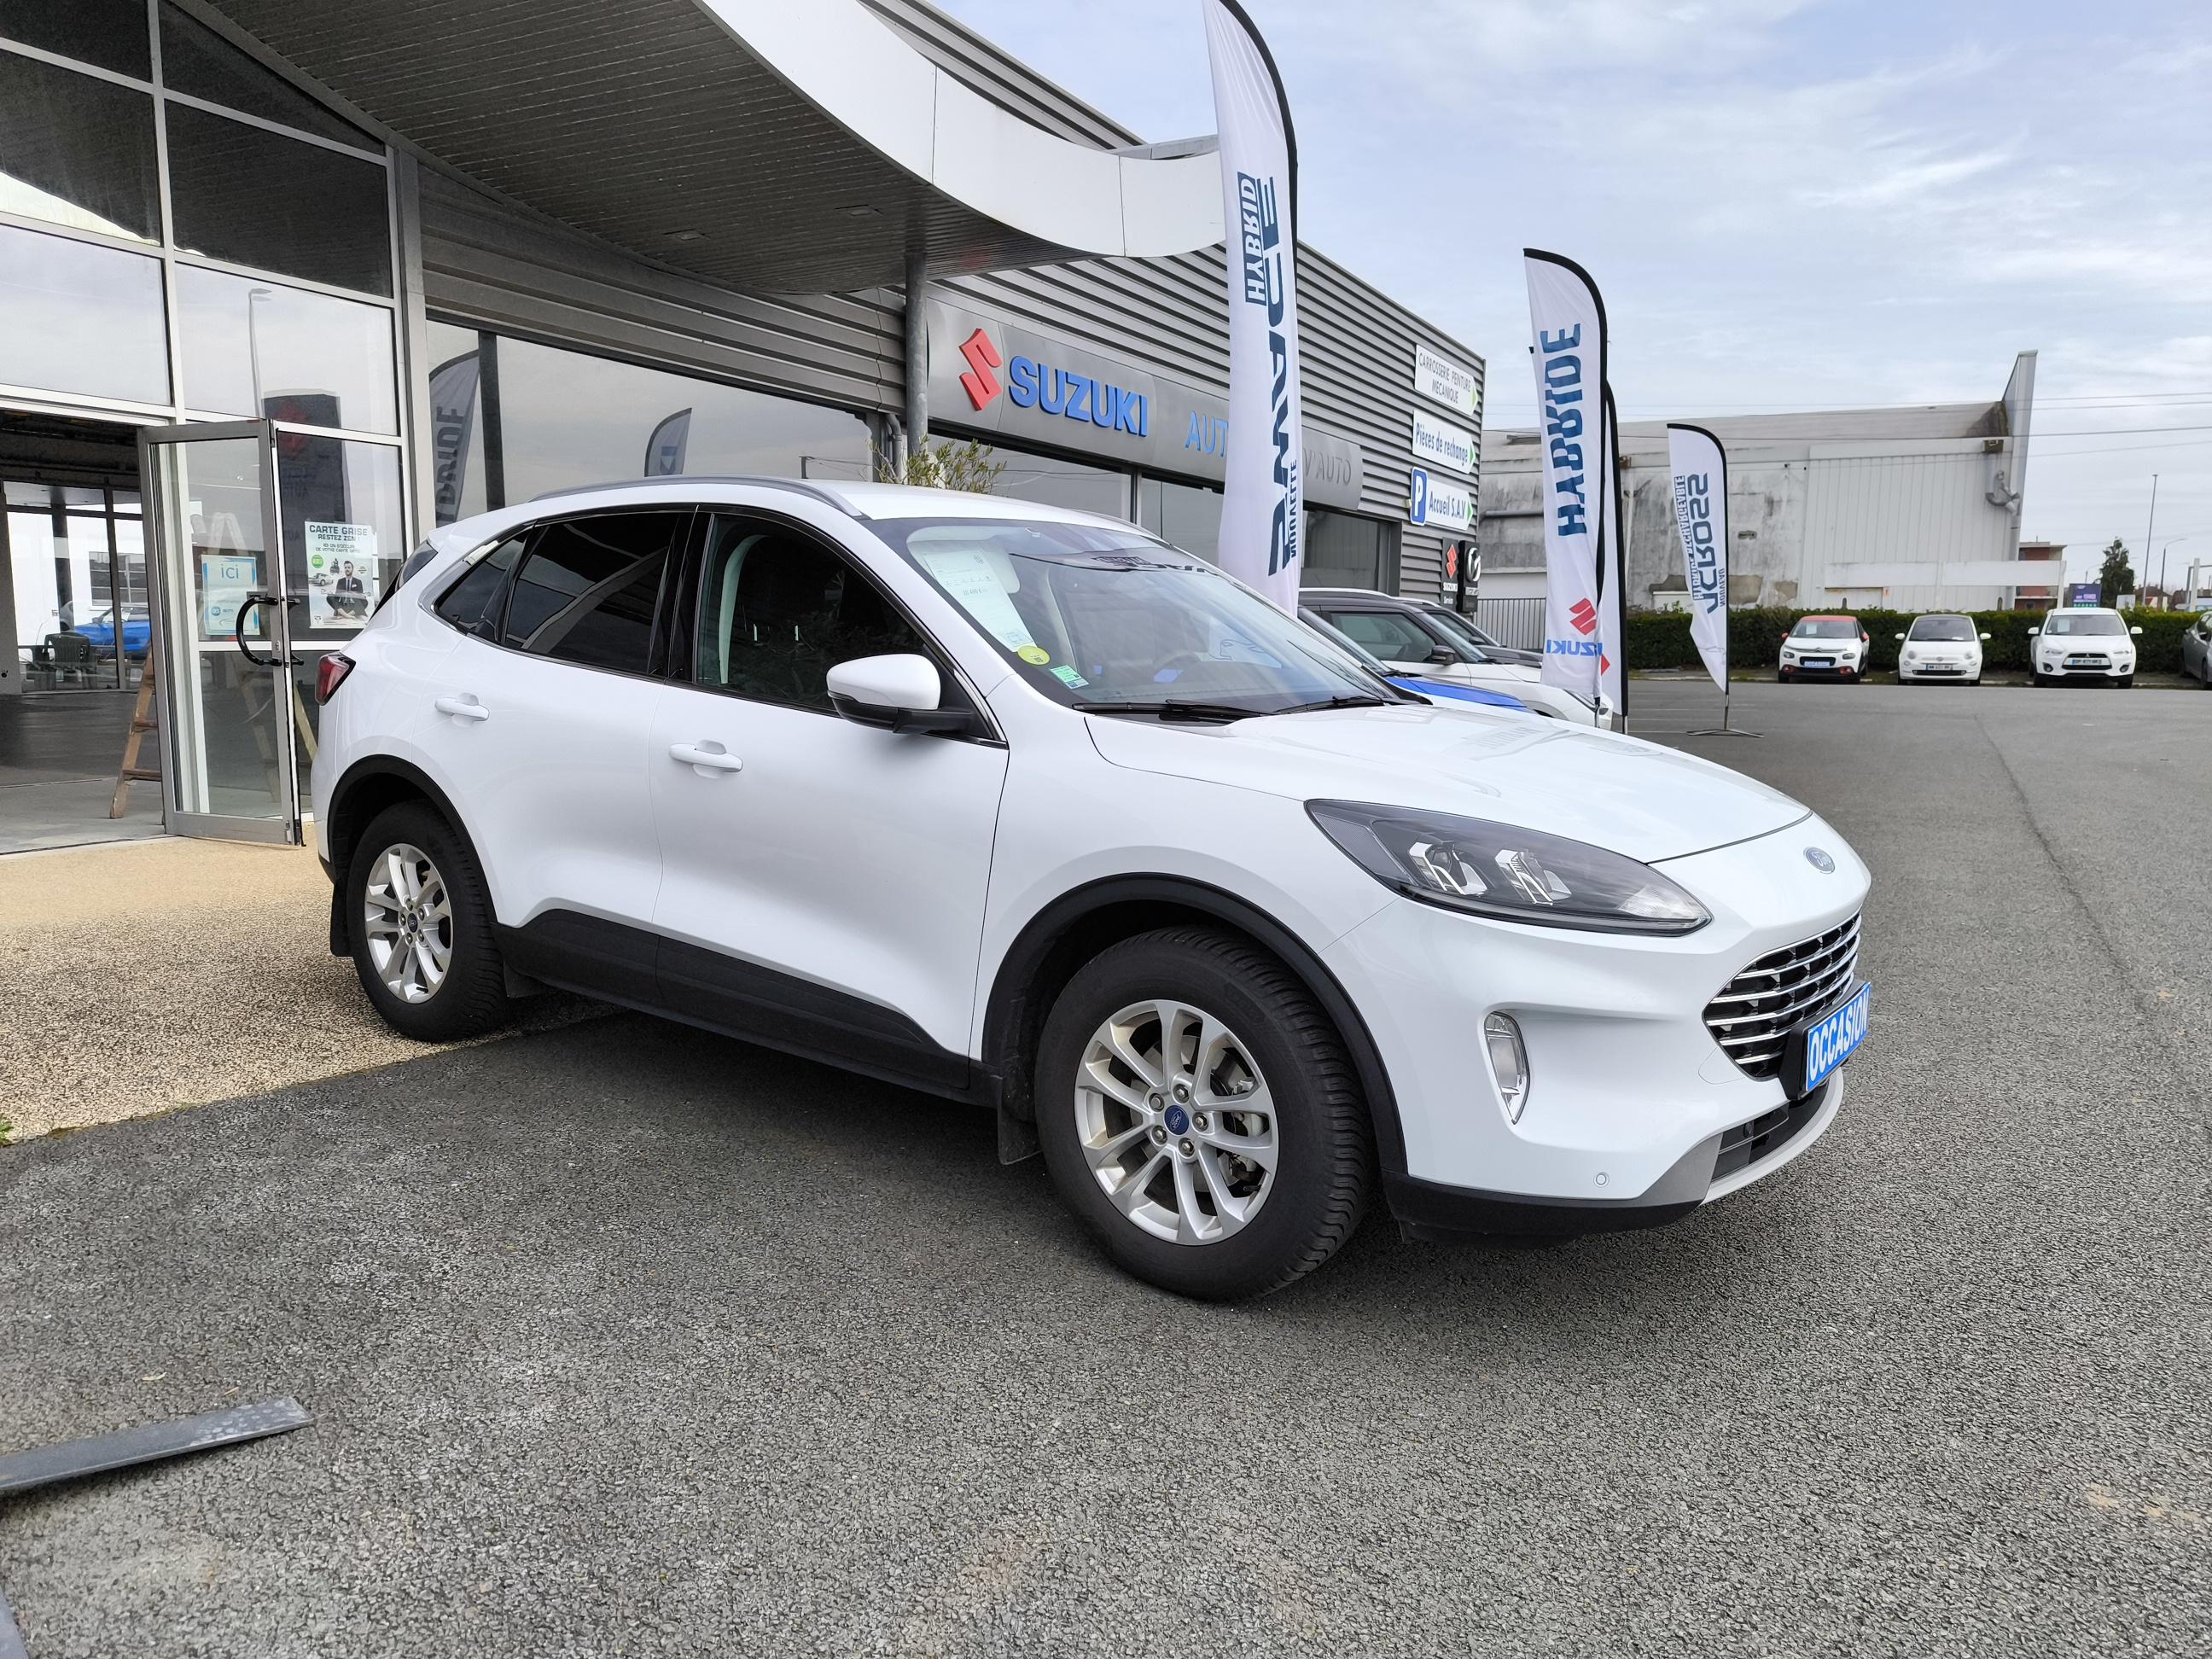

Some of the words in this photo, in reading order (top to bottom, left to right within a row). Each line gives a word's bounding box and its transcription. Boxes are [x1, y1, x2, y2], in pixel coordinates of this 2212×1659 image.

[1418, 352, 1449, 381] CARROSSERIE
[1452, 370, 1471, 393] PEINTURE
[1432, 378, 1458, 405] MECANIQUE
[1009, 355, 1148, 437] SUZUKI
[1185, 410, 1229, 458] AUT
[1416, 422, 1435, 450] Pièces
[1435, 430, 1443, 452] de
[1444, 437, 1468, 466] rechange
[1414, 475, 1423, 516] P
[1429, 491, 1450, 515] Accueil
[309, 524, 339, 535] CARTE
[341, 527, 368, 537] GRISE
[220, 563, 240, 579] ici
[1808, 992, 1870, 1083] OCCASION
